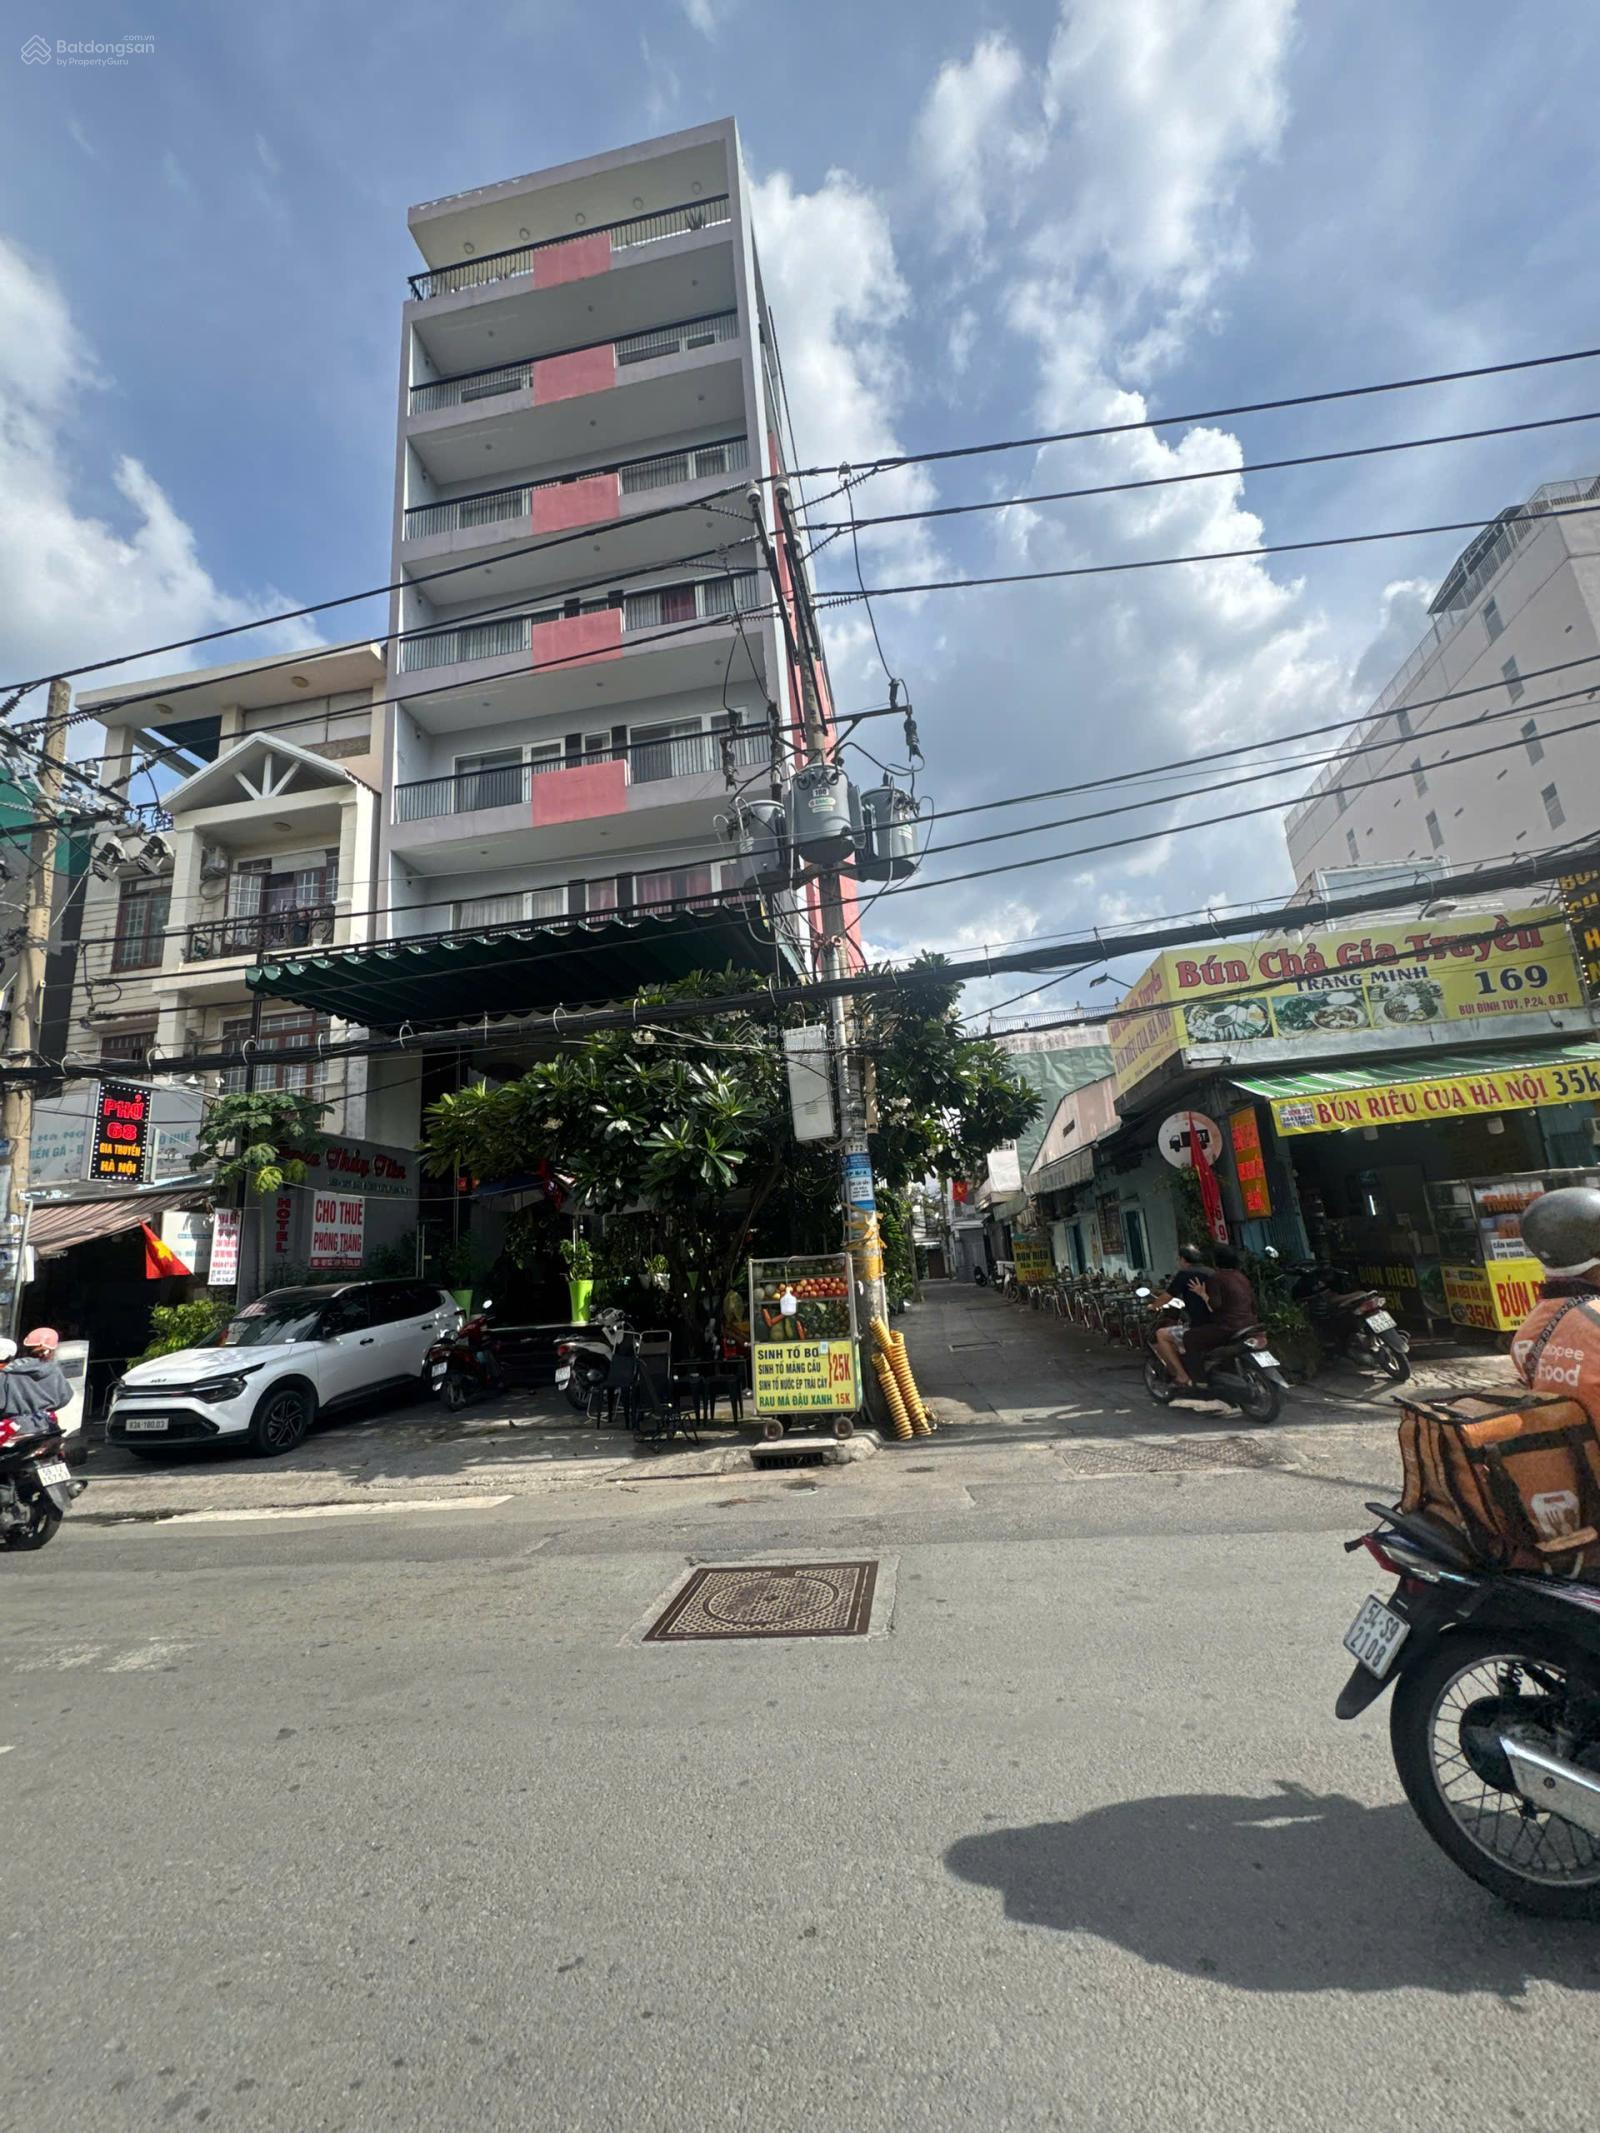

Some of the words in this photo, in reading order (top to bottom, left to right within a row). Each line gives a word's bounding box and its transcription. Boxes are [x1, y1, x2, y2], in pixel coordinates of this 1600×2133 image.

[1176, 955, 1250, 988] Bún
[1259, 943, 1328, 979] Chả
[1404, 914, 1544, 963] Truyền
[1296, 973, 1361, 992] TRANG
[1371, 966, 1429, 984] MINH
[1475, 965, 1549, 995] 169
[104, 1094, 145, 1120] PHỞ
[1316, 1096, 1362, 1124] BÚN
[1367, 1089, 1417, 1118] RIÊU
[1423, 1087, 1467, 1111] CUA
[1469, 1077, 1503, 1105] HÀ
[1505, 1073, 1548, 1105] NỘI
[107, 1122, 137, 1141] 68
[99, 1142, 112, 1155] GIA
[101, 1158, 115, 1172] HÀ
[117, 1160, 136, 1176] NỘI
[315, 1199, 337, 1224] CHO
[340, 1198, 363, 1226] THUÊ
[275, 1198, 292, 1254] HOTEL
[314, 1227, 338, 1252] PHÒNG
[340, 1229, 362, 1253] THÁNG
[1465, 1303, 1497, 1329] 35K
[757, 1349, 783, 1360] SINH
[786, 1344, 800, 1359] TỐ
[758, 1364, 774, 1375] SINH
[775, 1361, 784, 1374] TỐ
[832, 1353, 851, 1382] 25K
[758, 1379, 771, 1391] SINH
[759, 1396, 775, 1408] RAU
[777, 1392, 790, 1407] MÁ
[792, 1392, 809, 1408] ĐẬU
[811, 1394, 833, 1406] XANH
[835, 1393, 851, 1405] 15K
[1350, 1626, 1387, 1668] 2108
